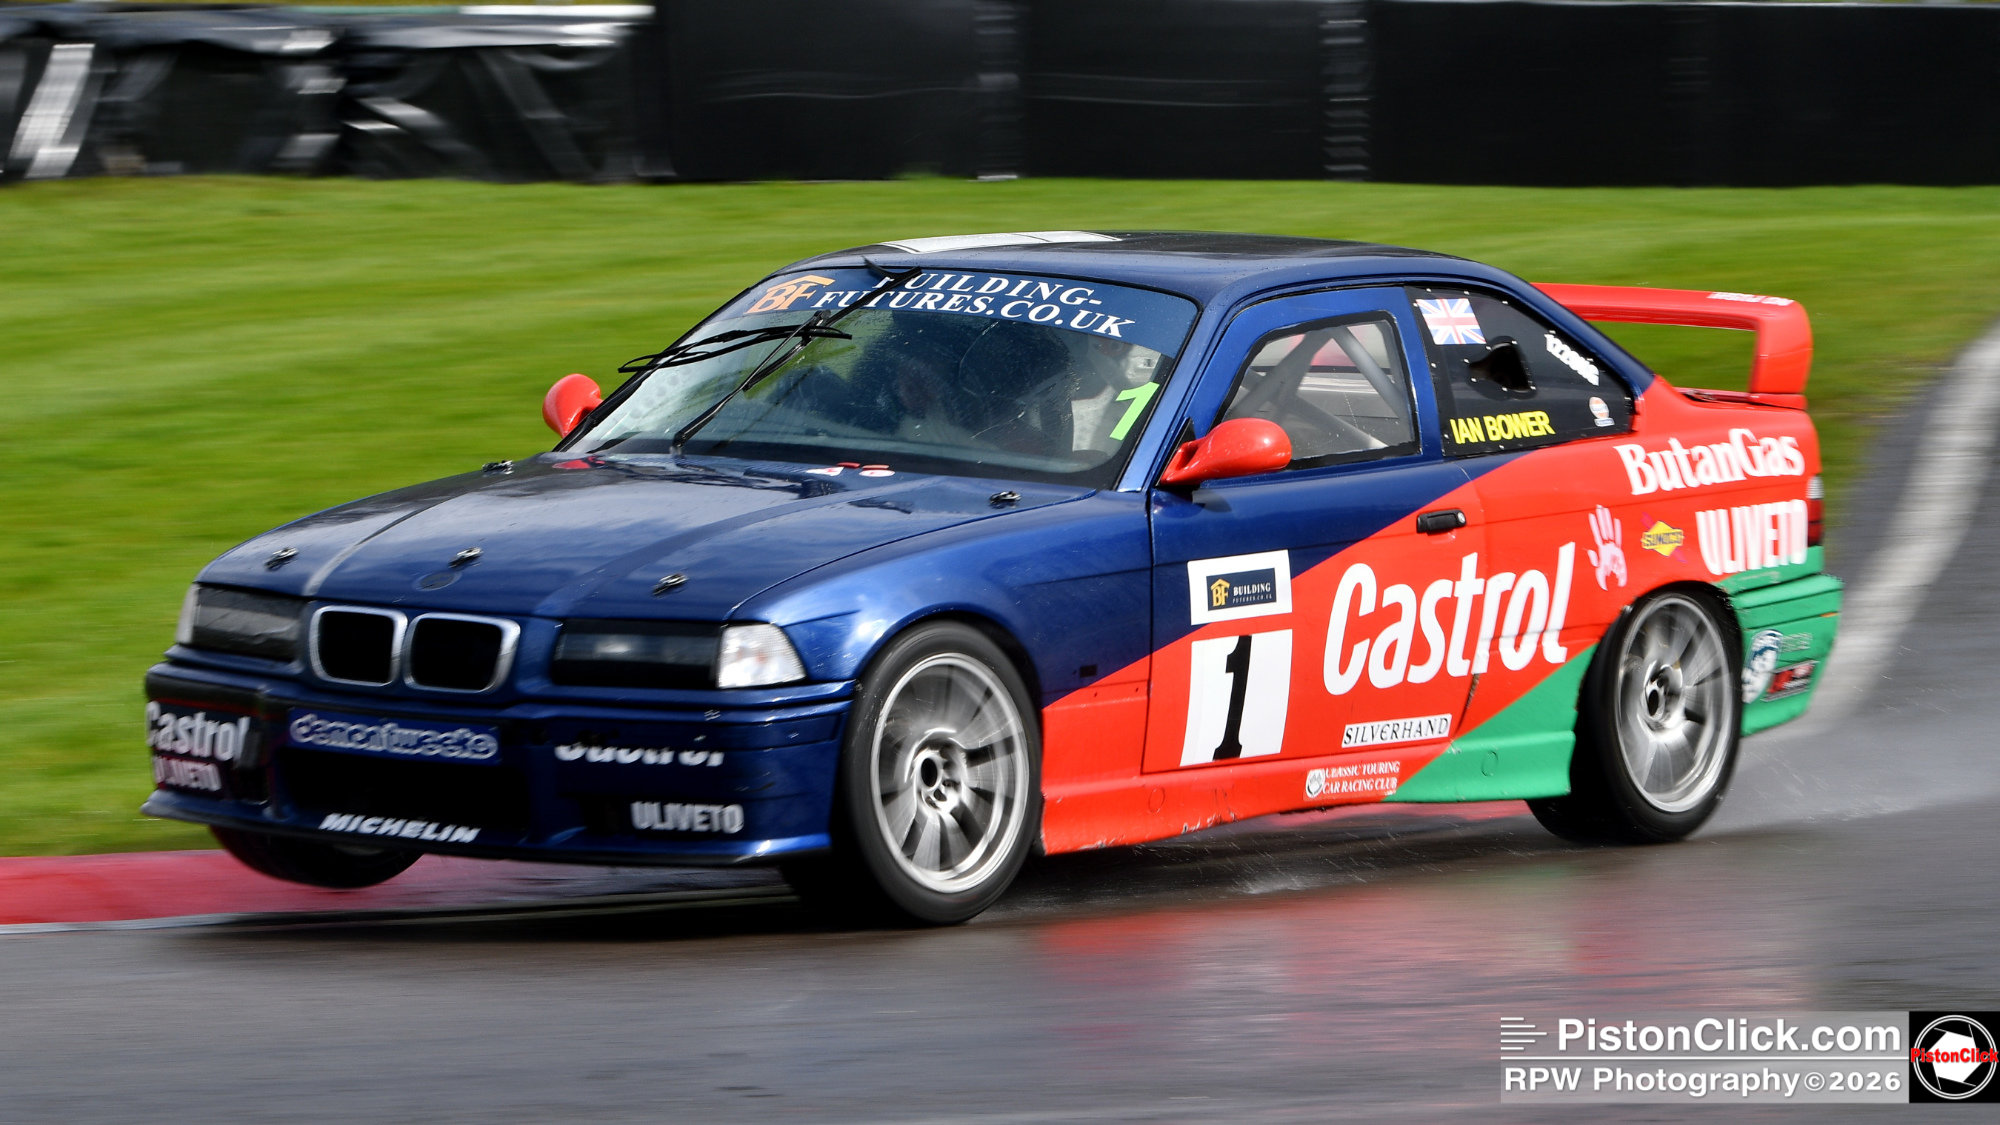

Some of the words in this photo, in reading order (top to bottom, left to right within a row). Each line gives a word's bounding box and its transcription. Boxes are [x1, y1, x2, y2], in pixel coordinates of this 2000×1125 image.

[872, 272, 1103, 306] UILDING-
[1109, 381, 1160, 441] 1
[1449, 416, 1486, 444] IAN
[1482, 410, 1556, 442] BOWER
[1613, 428, 1806, 495] ButanGas
[1695, 499, 1809, 576] ULIVETO
[1210, 579, 1230, 607] BF
[1233, 582, 1271, 597] BUILDING
[1323, 541, 1576, 696] Castrol
[1212, 635, 1252, 761] 1
[145, 701, 251, 764] Castrol
[1343, 717, 1449, 746] SILVERHAND
[1362, 760, 1401, 775] TOURING
[1322, 780, 1340, 794] CAR
[1341, 778, 1375, 793] RACING
[1375, 776, 1398, 790] CLUB
[318, 812, 482, 844] MICHELIN
[631, 801, 745, 834] ULIVETO
